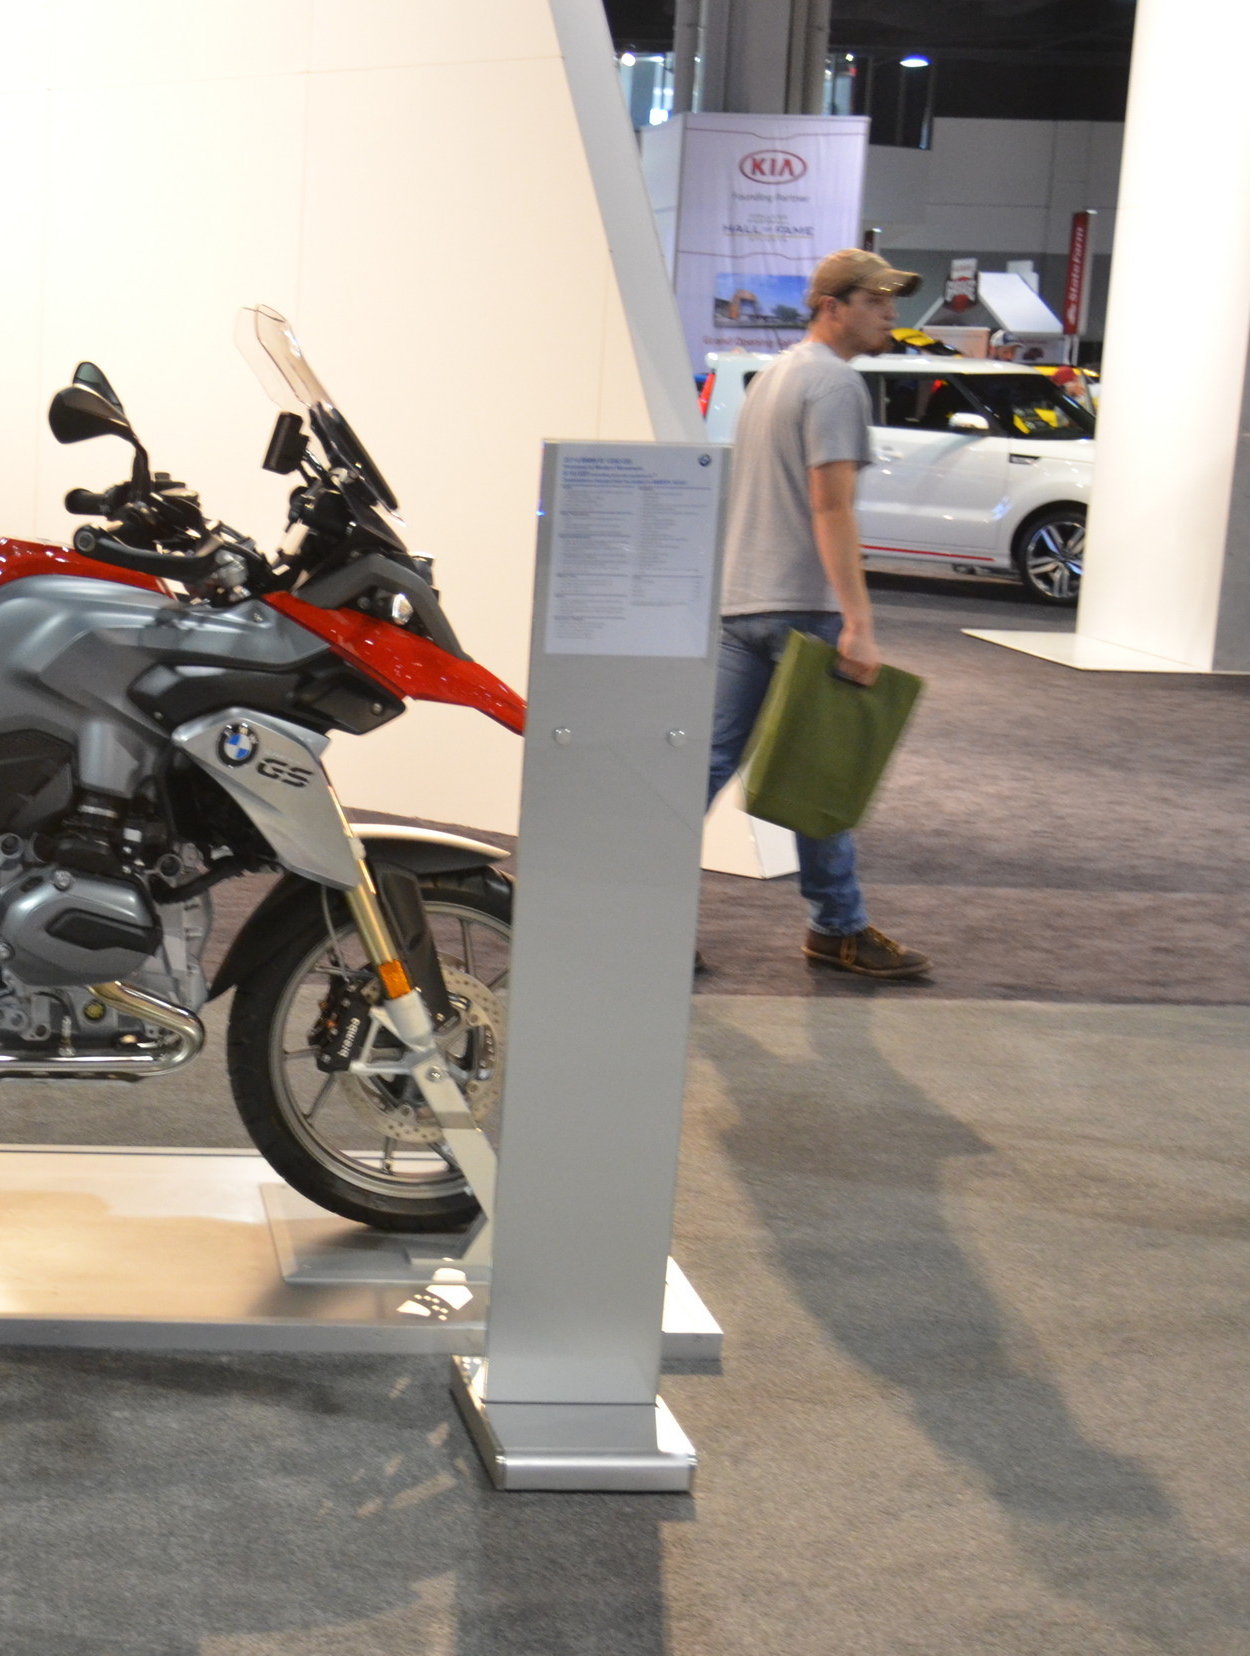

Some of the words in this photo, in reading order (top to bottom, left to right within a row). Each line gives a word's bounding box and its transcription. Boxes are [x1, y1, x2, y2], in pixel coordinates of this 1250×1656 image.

[751, 158, 794, 176] KIA
[256, 757, 314, 787] GS
[337, 1017, 361, 1058] brembo
